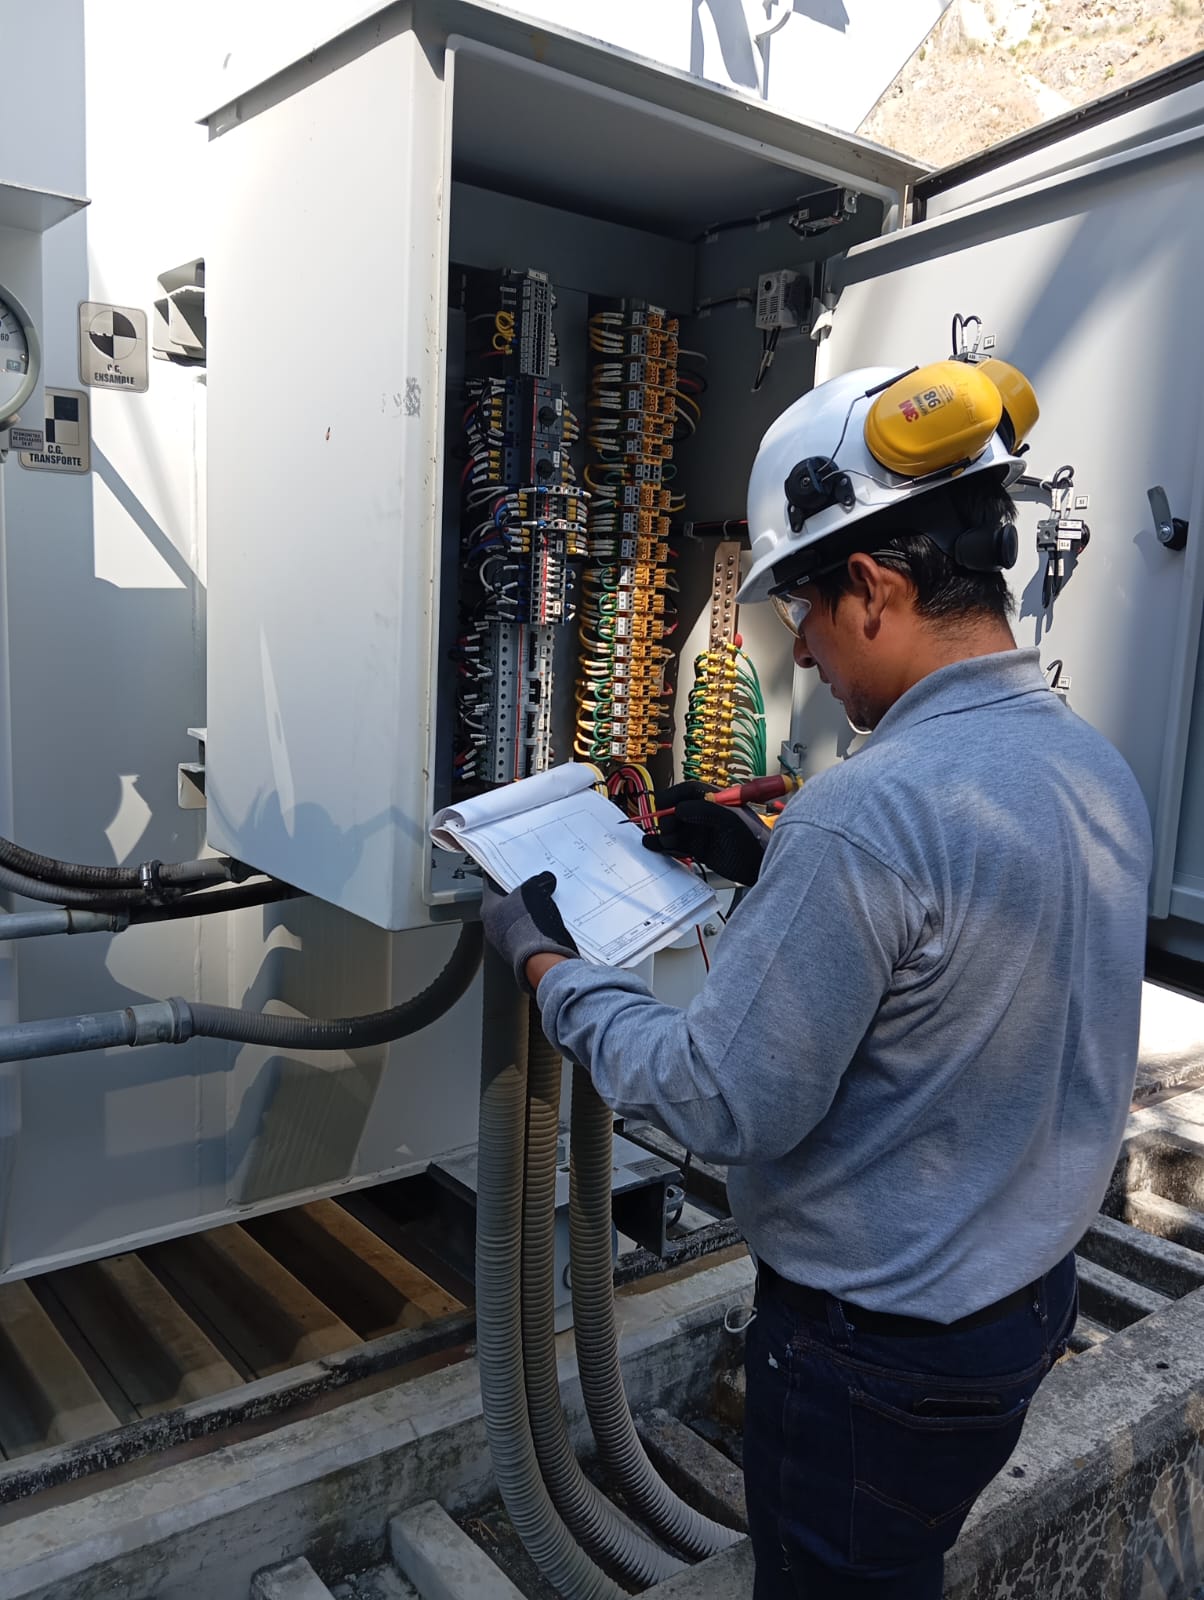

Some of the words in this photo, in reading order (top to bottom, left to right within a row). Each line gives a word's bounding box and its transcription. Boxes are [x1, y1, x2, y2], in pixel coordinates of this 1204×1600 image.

[107, 364, 122, 374] CG.
[924, 391, 942, 408] 98
[898, 400, 919, 423] 3M
[47, 444, 64, 454] C.G.
[29, 453, 82, 466] TRANSPORTE
